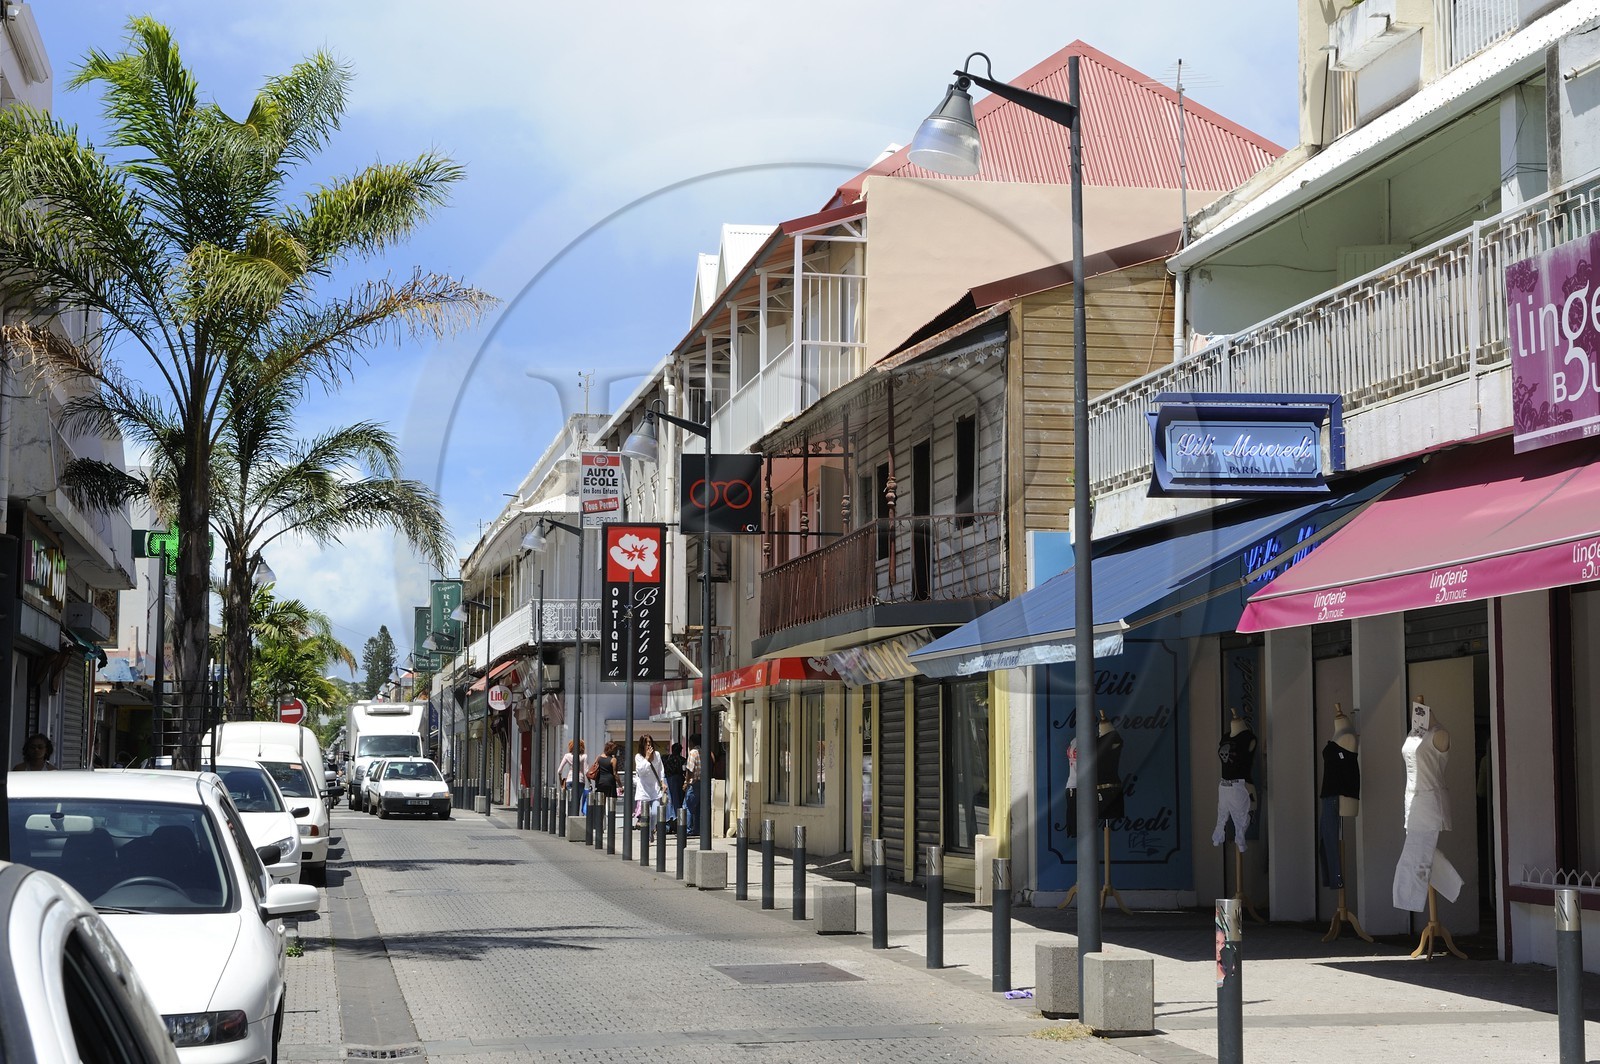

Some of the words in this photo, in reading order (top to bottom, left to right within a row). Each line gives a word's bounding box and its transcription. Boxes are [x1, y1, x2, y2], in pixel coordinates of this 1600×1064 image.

[1176, 433, 1217, 458] Lili
[1222, 433, 1313, 458] Mercredi
[586, 468, 615, 477] AUTO
[1229, 466, 1261, 474] PARIS
[583, 477, 618, 487] ECOLE
[602, 487, 618, 495] Enfants
[584, 500, 598, 511] Tous
[599, 498, 617, 510] Permis
[742, 524, 758, 532] ACV
[1430, 567, 1468, 589] lingerie
[1313, 589, 1347, 610] lingerie
[1435, 586, 1468, 603] BOUTIQUE
[1318, 605, 1345, 620] BOUTIQUE
[611, 587, 619, 662] OPTIQUE
[633, 586, 660, 677] Bourbon
[608, 666, 619, 677] de
[490, 690, 509, 702] Lido
[1053, 705, 1171, 730] Mcredi
